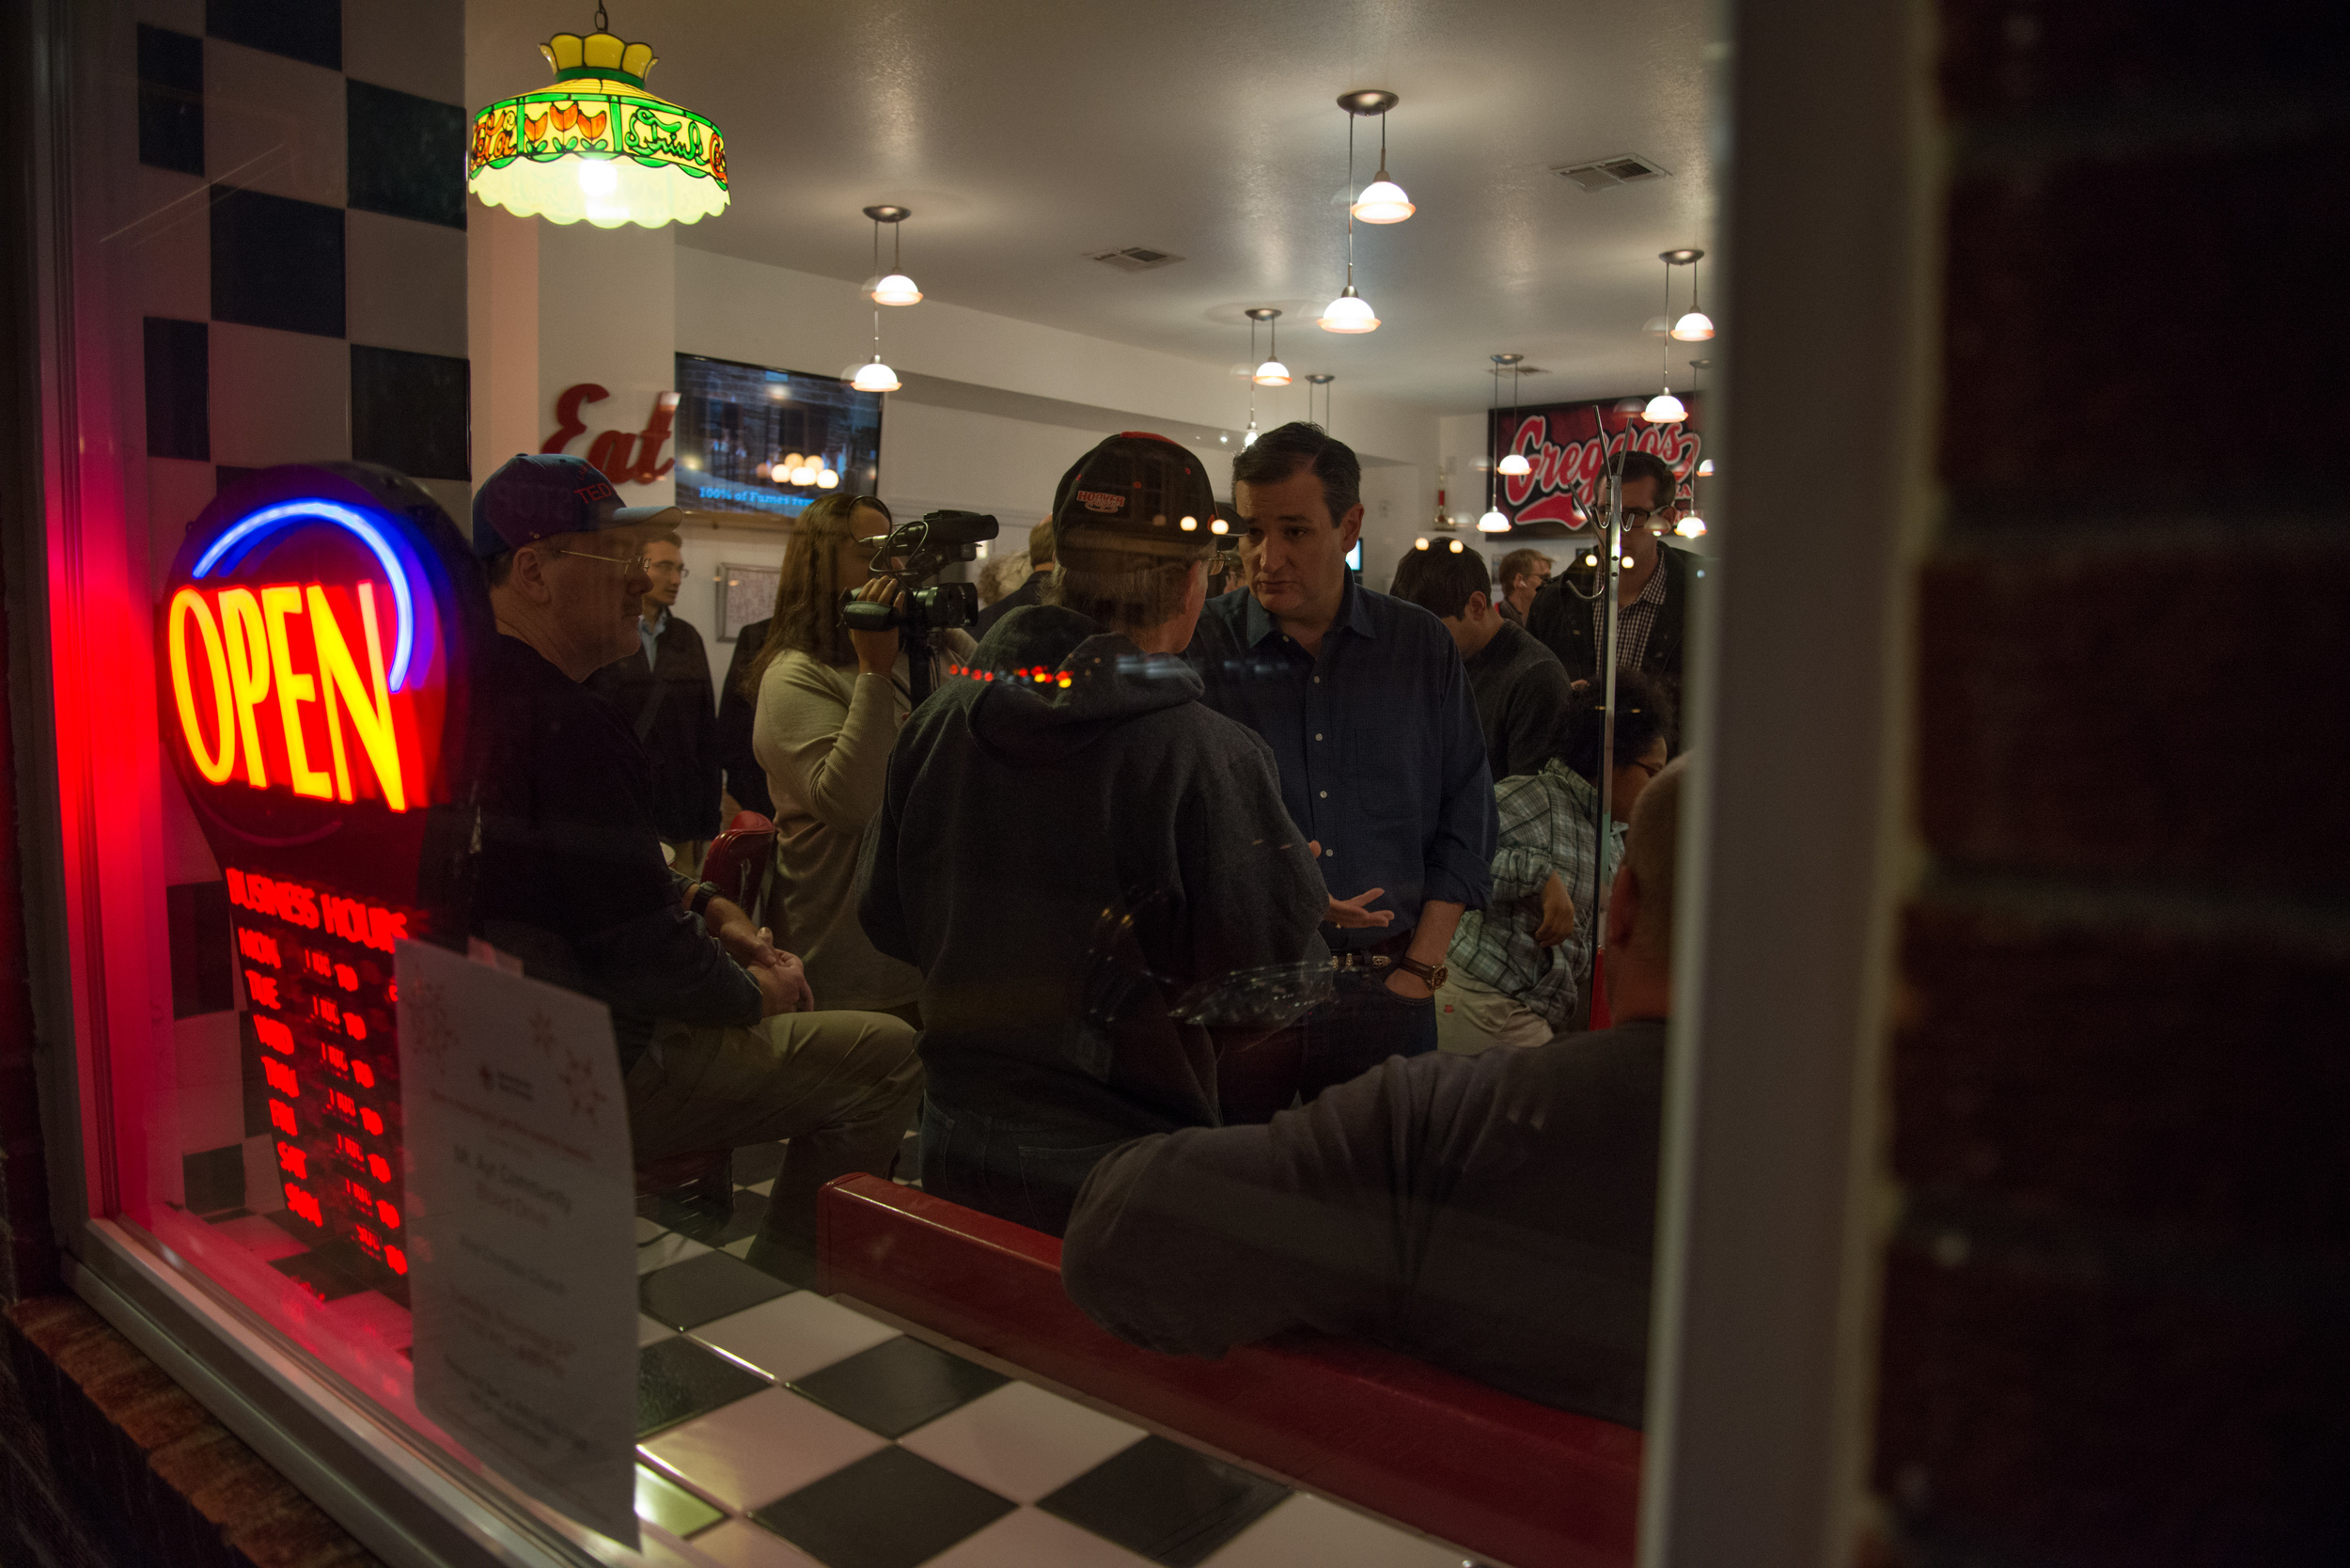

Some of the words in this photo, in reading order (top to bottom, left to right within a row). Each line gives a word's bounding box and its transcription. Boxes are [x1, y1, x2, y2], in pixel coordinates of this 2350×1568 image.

[540, 384, 682, 484] Eat
[573, 482, 612, 504] TED
[698, 486, 732, 500] 100%
[734, 490, 747, 501] of
[168, 578, 407, 814] OPEN
